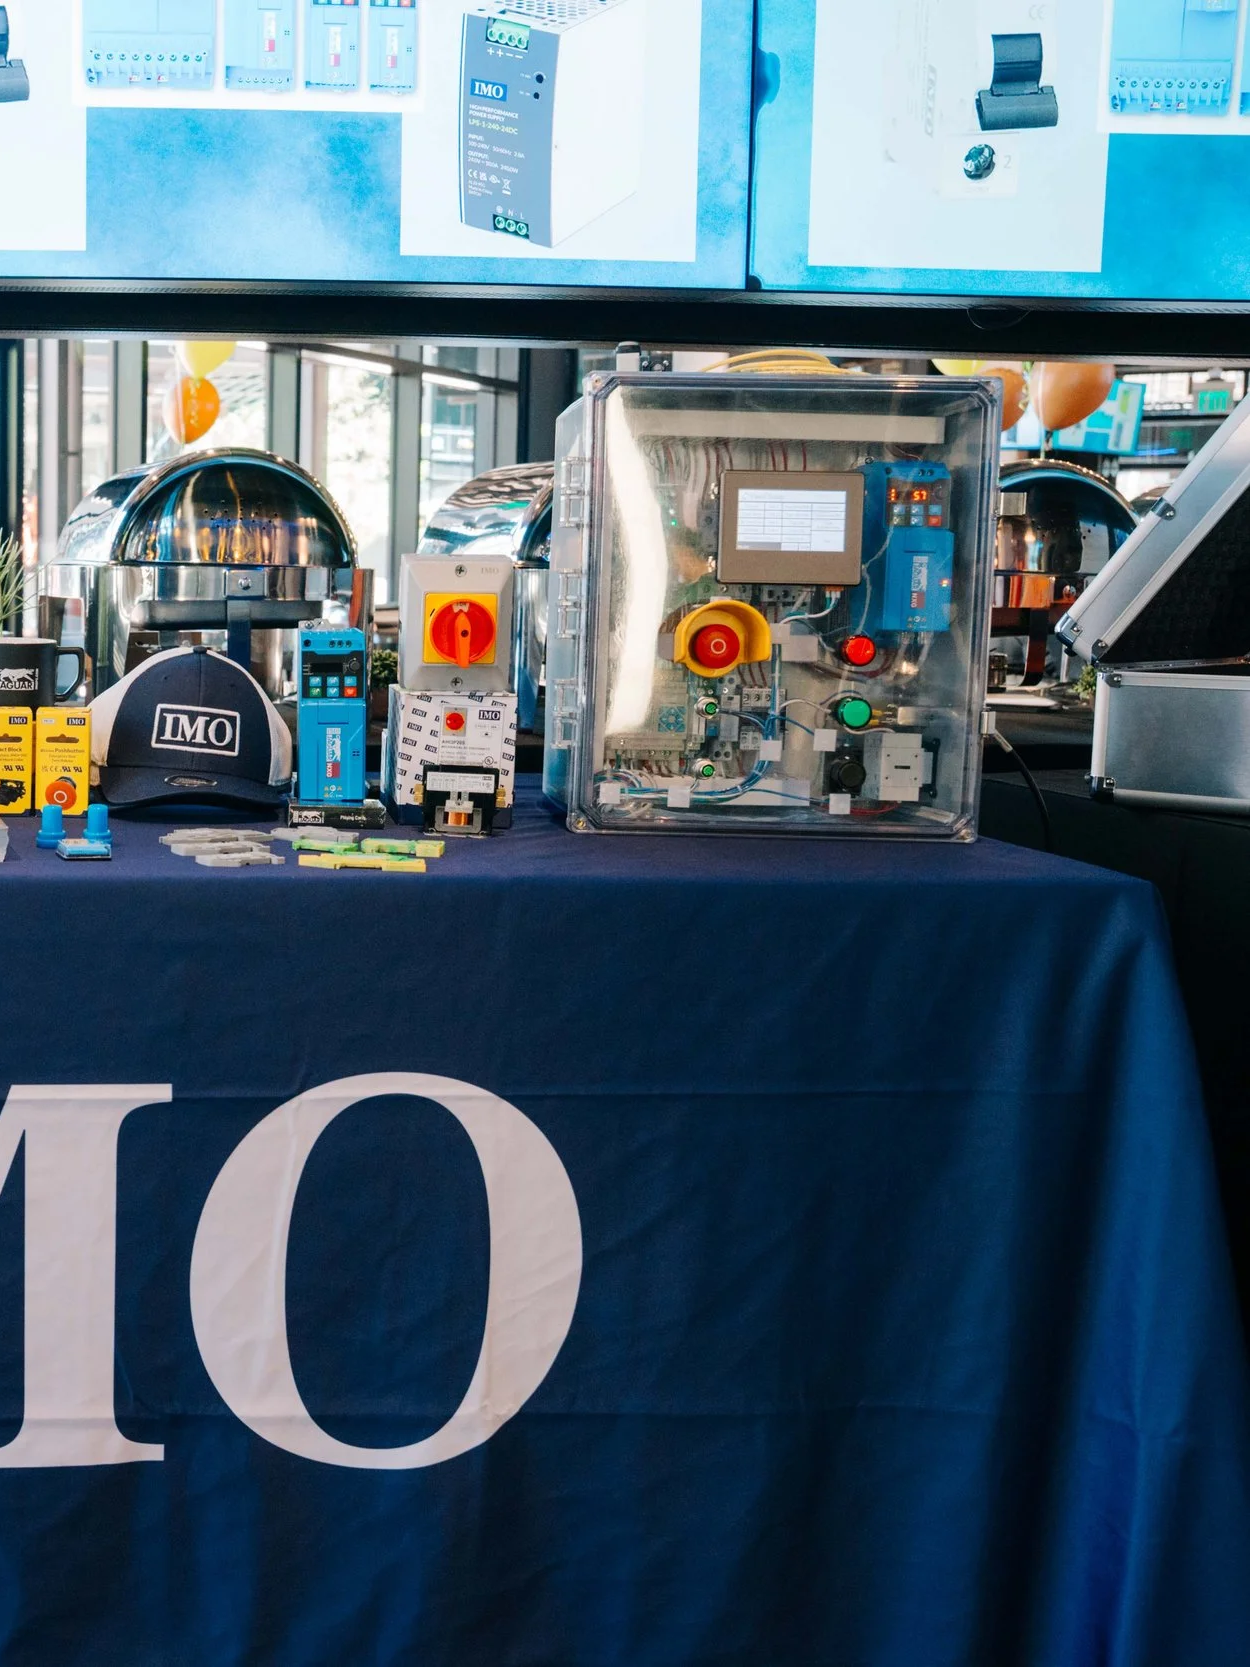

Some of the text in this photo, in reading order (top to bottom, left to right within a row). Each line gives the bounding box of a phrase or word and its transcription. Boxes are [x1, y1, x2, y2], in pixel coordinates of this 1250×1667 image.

[474, 81, 504, 98] IMO
[469, 110, 487, 118] POWER
[480, 711, 500, 720] IMO
[160, 712, 233, 747] IMO
